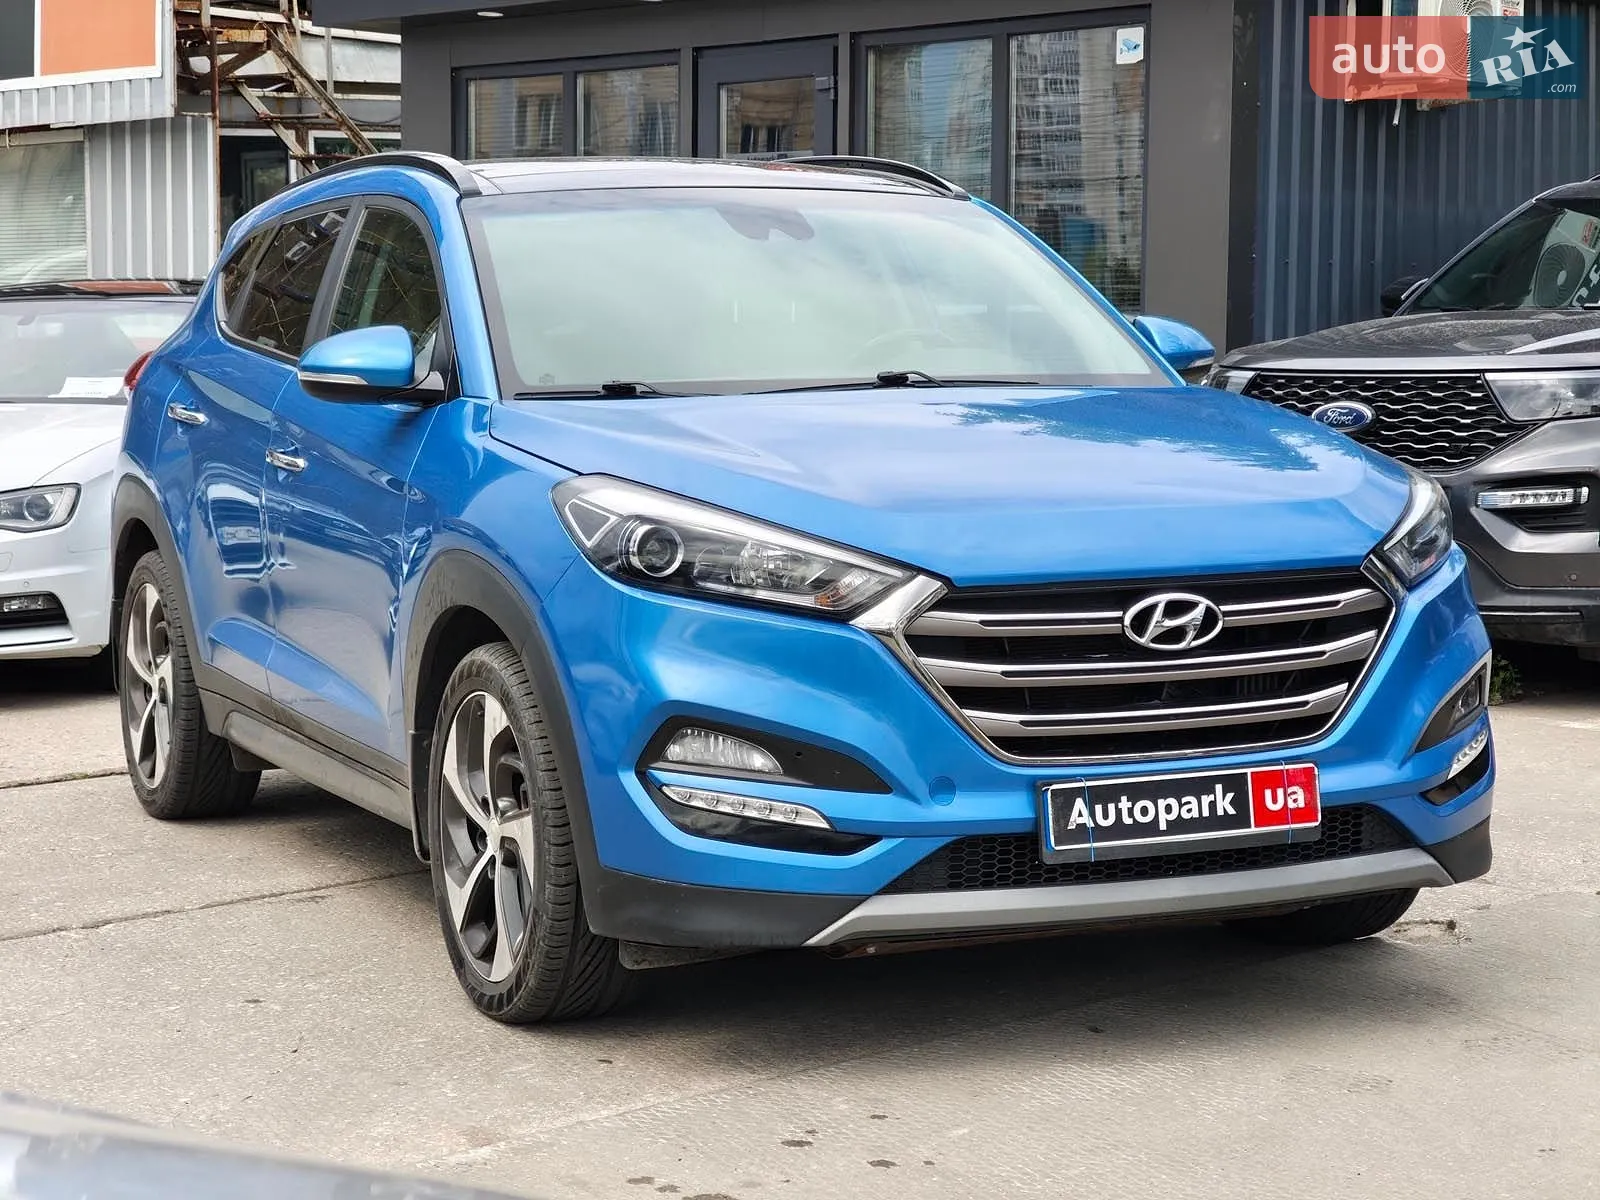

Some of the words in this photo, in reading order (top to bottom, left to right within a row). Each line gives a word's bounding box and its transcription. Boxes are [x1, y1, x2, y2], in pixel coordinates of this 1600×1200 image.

[1323, 408, 1357, 425] Ford
[1067, 783, 1236, 830] Autopark
[1264, 784, 1306, 812] ua
